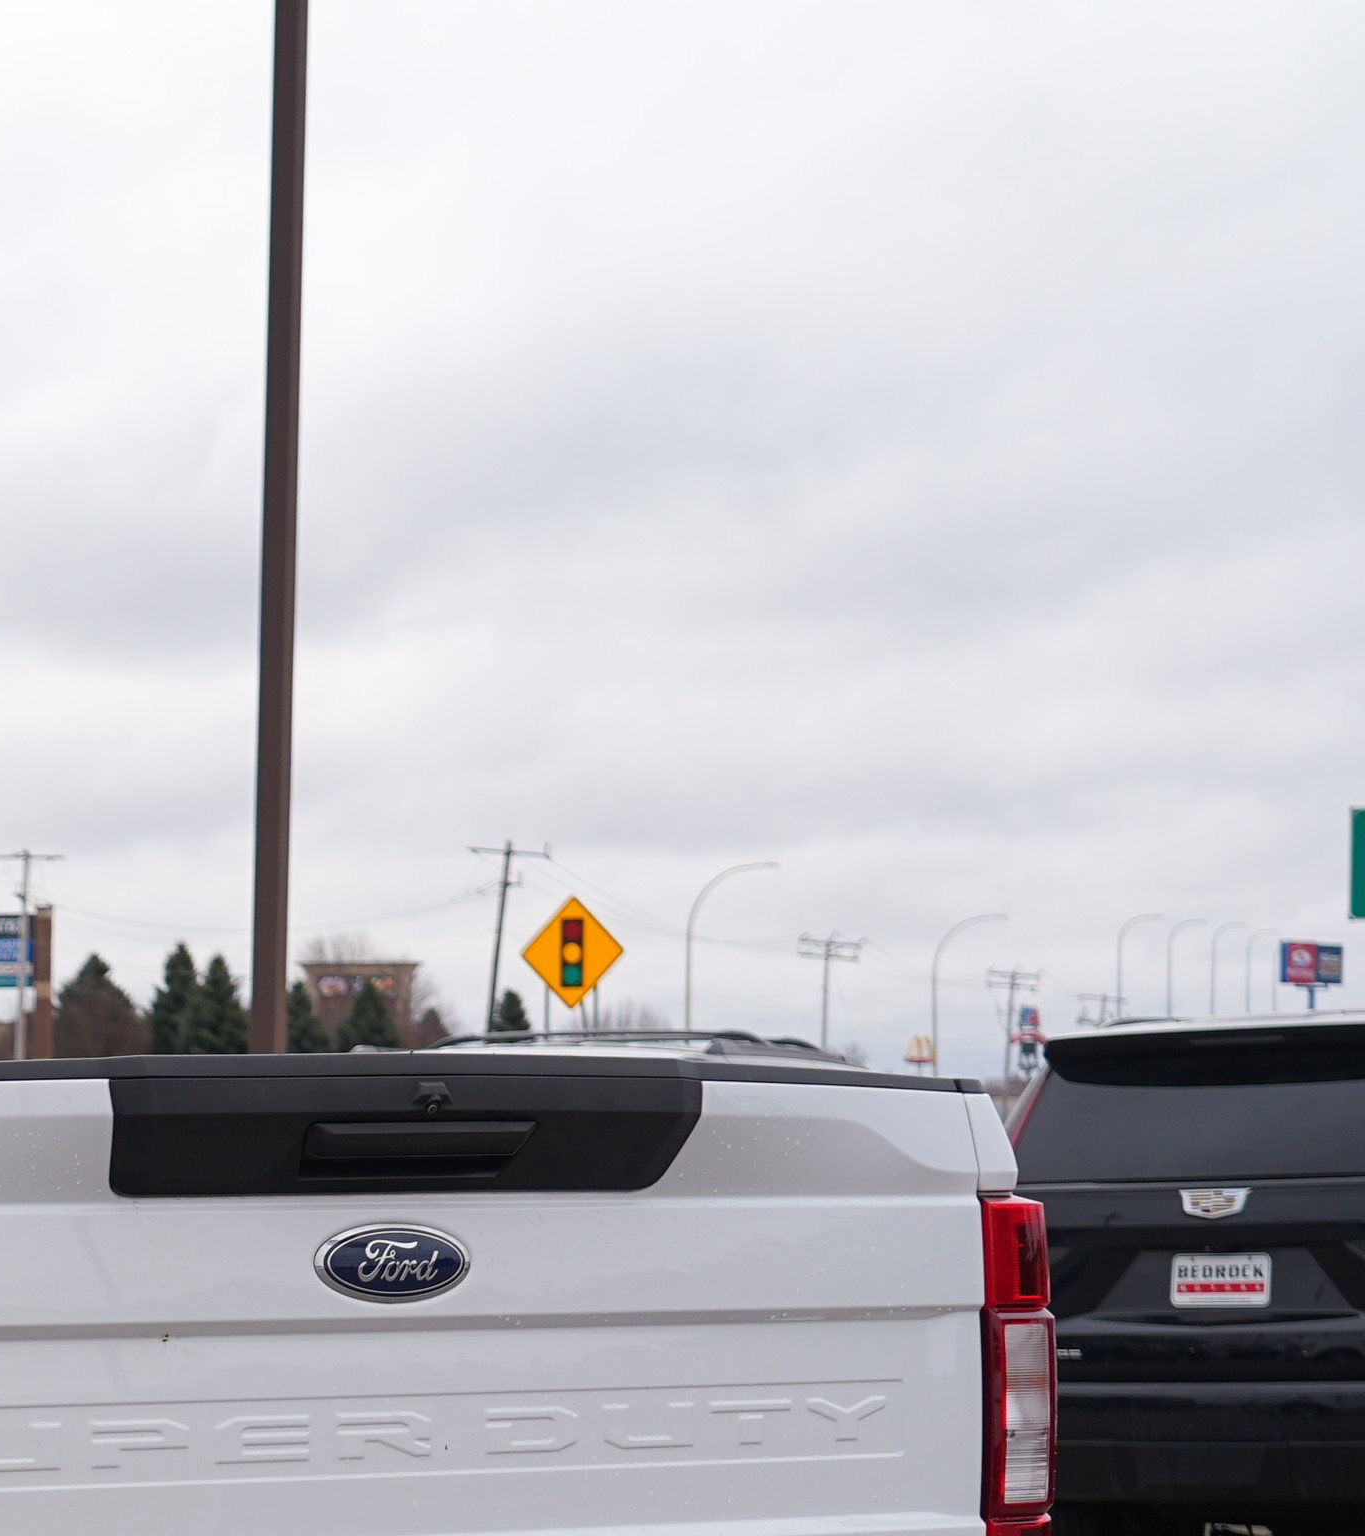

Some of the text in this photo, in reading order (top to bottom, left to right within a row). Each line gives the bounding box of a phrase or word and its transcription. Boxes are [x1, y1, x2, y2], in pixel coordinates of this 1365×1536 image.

[358, 1239, 439, 1282] Ford
[1177, 1264, 1264, 1278] BEDROCK
[485, 1396, 887, 1455] DUTY
